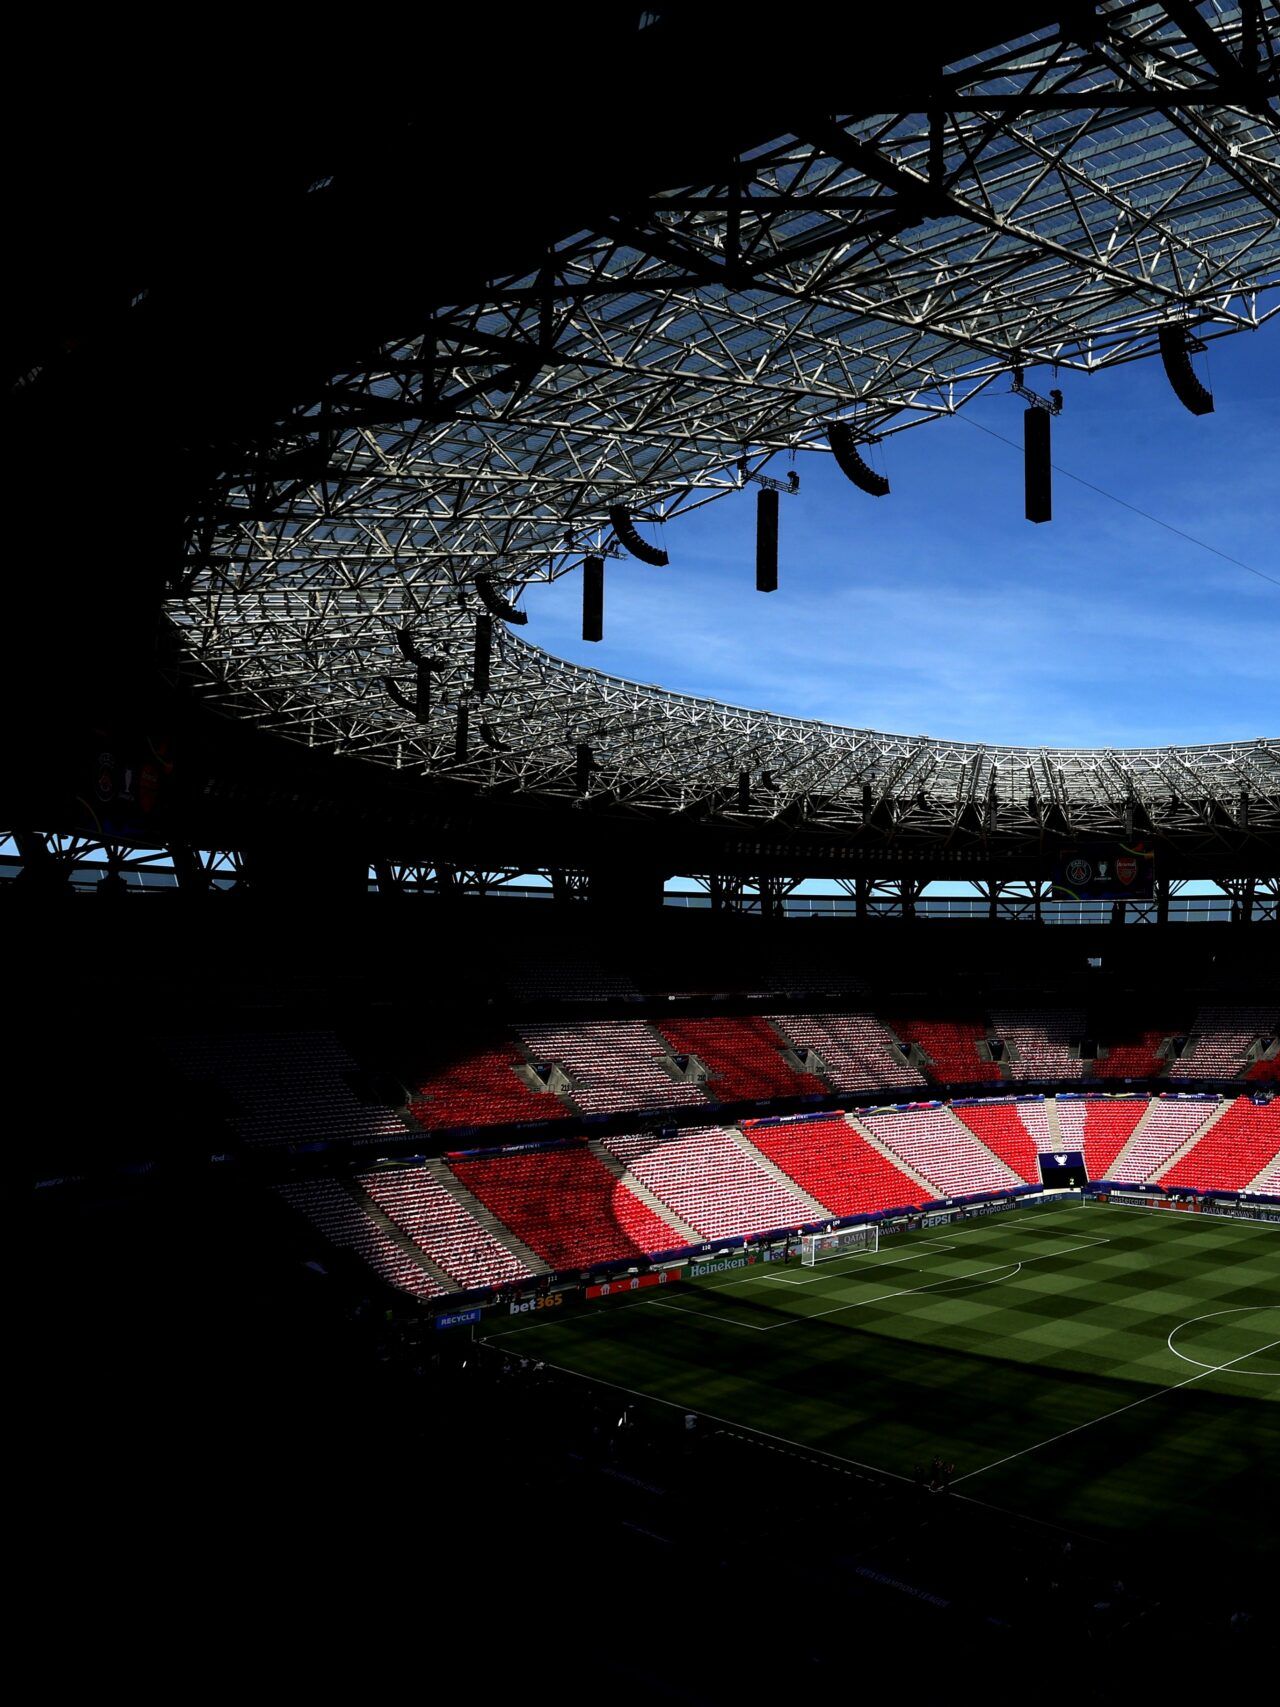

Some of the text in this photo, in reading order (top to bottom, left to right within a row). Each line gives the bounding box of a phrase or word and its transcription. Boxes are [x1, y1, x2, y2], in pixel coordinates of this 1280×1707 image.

[1108, 1196, 1146, 1206] mastercard
[979, 1202, 1016, 1217] crypto.com
[1202, 1206, 1254, 1219] QATAR AIRWAYS
[922, 1214, 951, 1229] PEPSI
[690, 1257, 746, 1278] Heineken
[509, 1293, 563, 1315] bet365
[441, 1312, 476, 1325] RECYCLE
